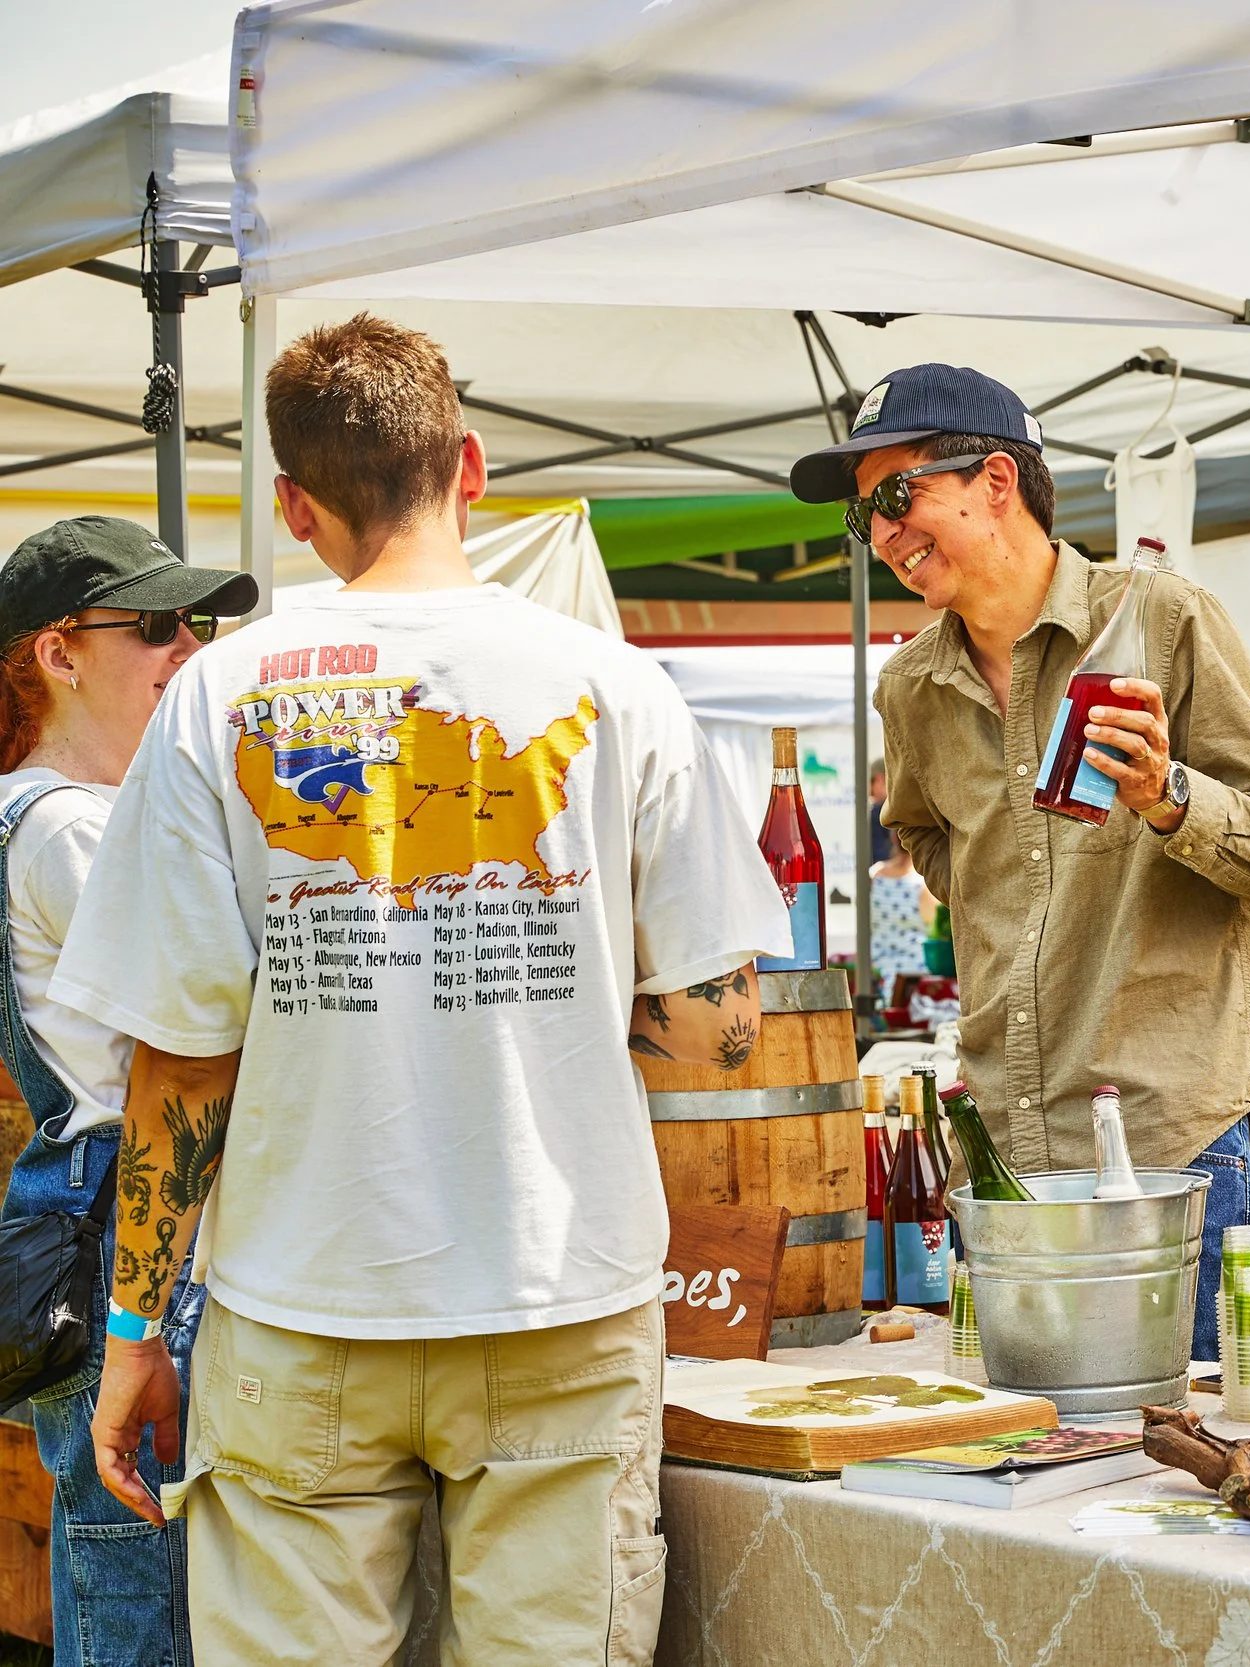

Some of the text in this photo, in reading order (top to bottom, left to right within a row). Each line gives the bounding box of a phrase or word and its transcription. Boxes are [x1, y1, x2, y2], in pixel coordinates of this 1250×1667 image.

[259, 644, 377, 685] HOT ROD
[236, 685, 408, 736] POWER
[350, 733, 401, 761] '99
[289, 881, 358, 909] Greatest
[368, 876, 420, 898] Road
[425, 874, 468, 901] Trip
[475, 871, 508, 890] On
[517, 868, 591, 890] Earth!
[265, 914, 285, 930] May
[288, 914, 299, 929] 13
[310, 908, 328, 924] San
[331, 905, 379, 923] Bernardino,
[383, 905, 428, 923] California
[434, 904, 453, 922] May
[456, 902, 465, 918] 18
[475, 901, 509, 916] Kansas
[512, 900, 534, 918] City,
[538, 898, 580, 914] Missouri
[266, 935, 288, 952] May
[290, 935, 303, 949] 14
[348, 928, 386, 944] Arizona
[434, 927, 453, 945] May
[456, 928, 466, 941] 20
[476, 923, 520, 939] Madison,
[524, 921, 557, 936] Illinois
[269, 956, 289, 973] May
[292, 956, 304, 971] 15
[366, 951, 386, 967] New
[389, 951, 421, 966] Mexico
[434, 949, 453, 967] May
[456, 950, 465, 963] 21
[475, 944, 524, 961] Louisville,
[527, 941, 576, 959] Kentucky
[271, 977, 292, 994] May
[294, 974, 307, 990] 16
[348, 973, 373, 990] Texas
[434, 971, 453, 990] May
[456, 973, 467, 985] 22
[476, 966, 523, 983] Nashville,
[526, 964, 576, 980] Tennessee
[273, 999, 294, 1016] May
[297, 999, 308, 1015] 17
[434, 994, 453, 1012] May
[456, 995, 466, 1012] 23
[475, 988, 522, 1006] Nashville,
[526, 986, 575, 1002] Tennessee
